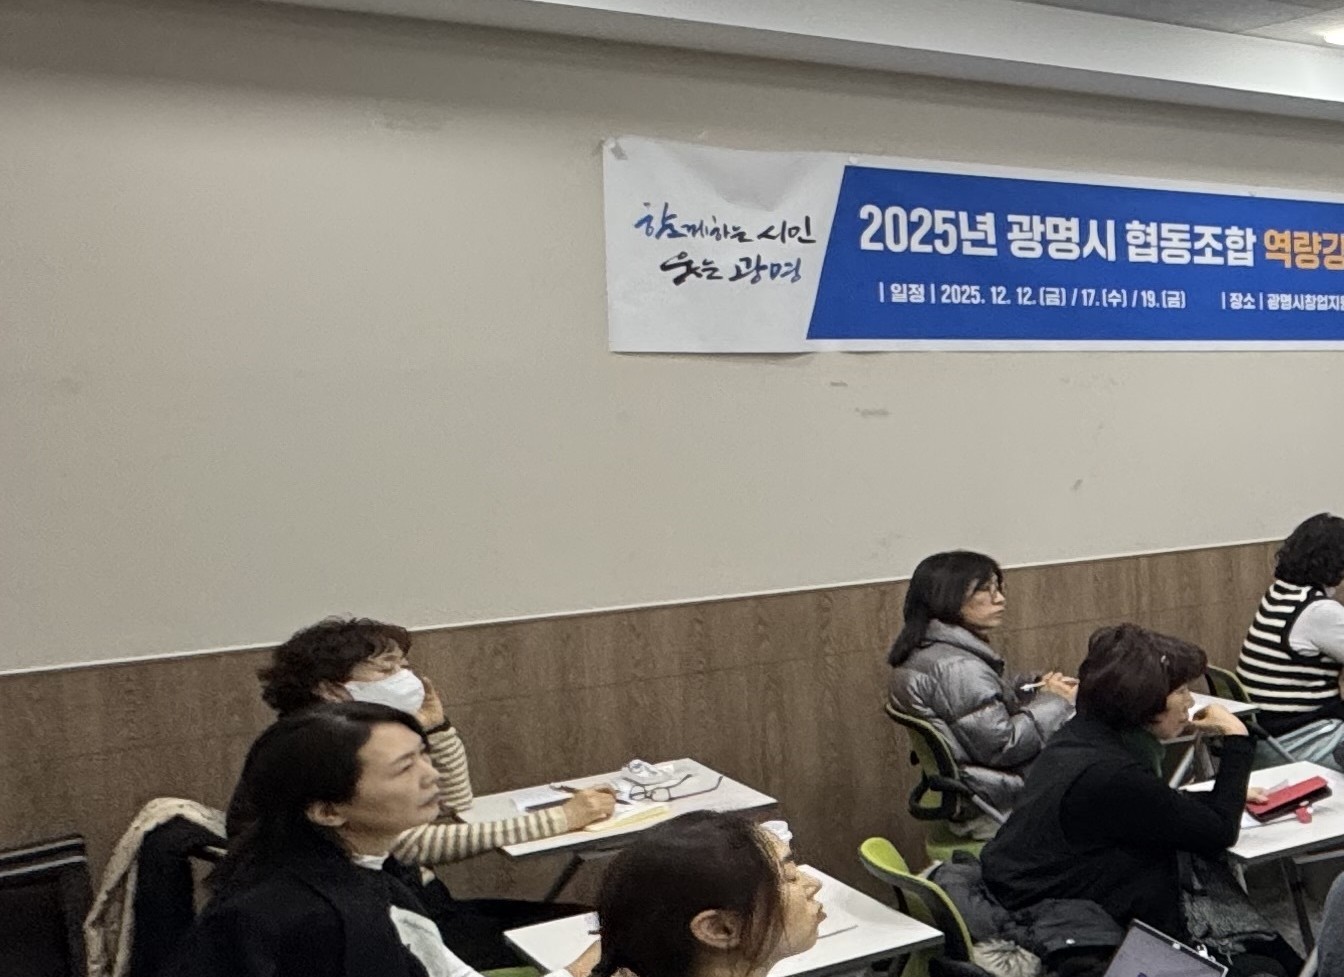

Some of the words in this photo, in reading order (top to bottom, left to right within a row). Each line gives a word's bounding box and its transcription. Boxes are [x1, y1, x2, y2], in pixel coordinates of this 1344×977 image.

[634, 202, 753, 243] 함께하는
[757, 216, 816, 244] 시민
[859, 204, 998, 257] 2025년
[1007, 213, 1116, 262] 광명시
[1125, 218, 1257, 267] 협동조합
[660, 251, 723, 286] 웃는
[728, 254, 802, 284] 광명
[890, 283, 925, 303] 일정
[940, 284, 986, 304] 2025.
[990, 286, 1011, 305] 12.
[1081, 288, 1128, 308] 17.(수)
[1141, 290, 1186, 309] 19.(금)
[1229, 292, 1256, 310] 장소
